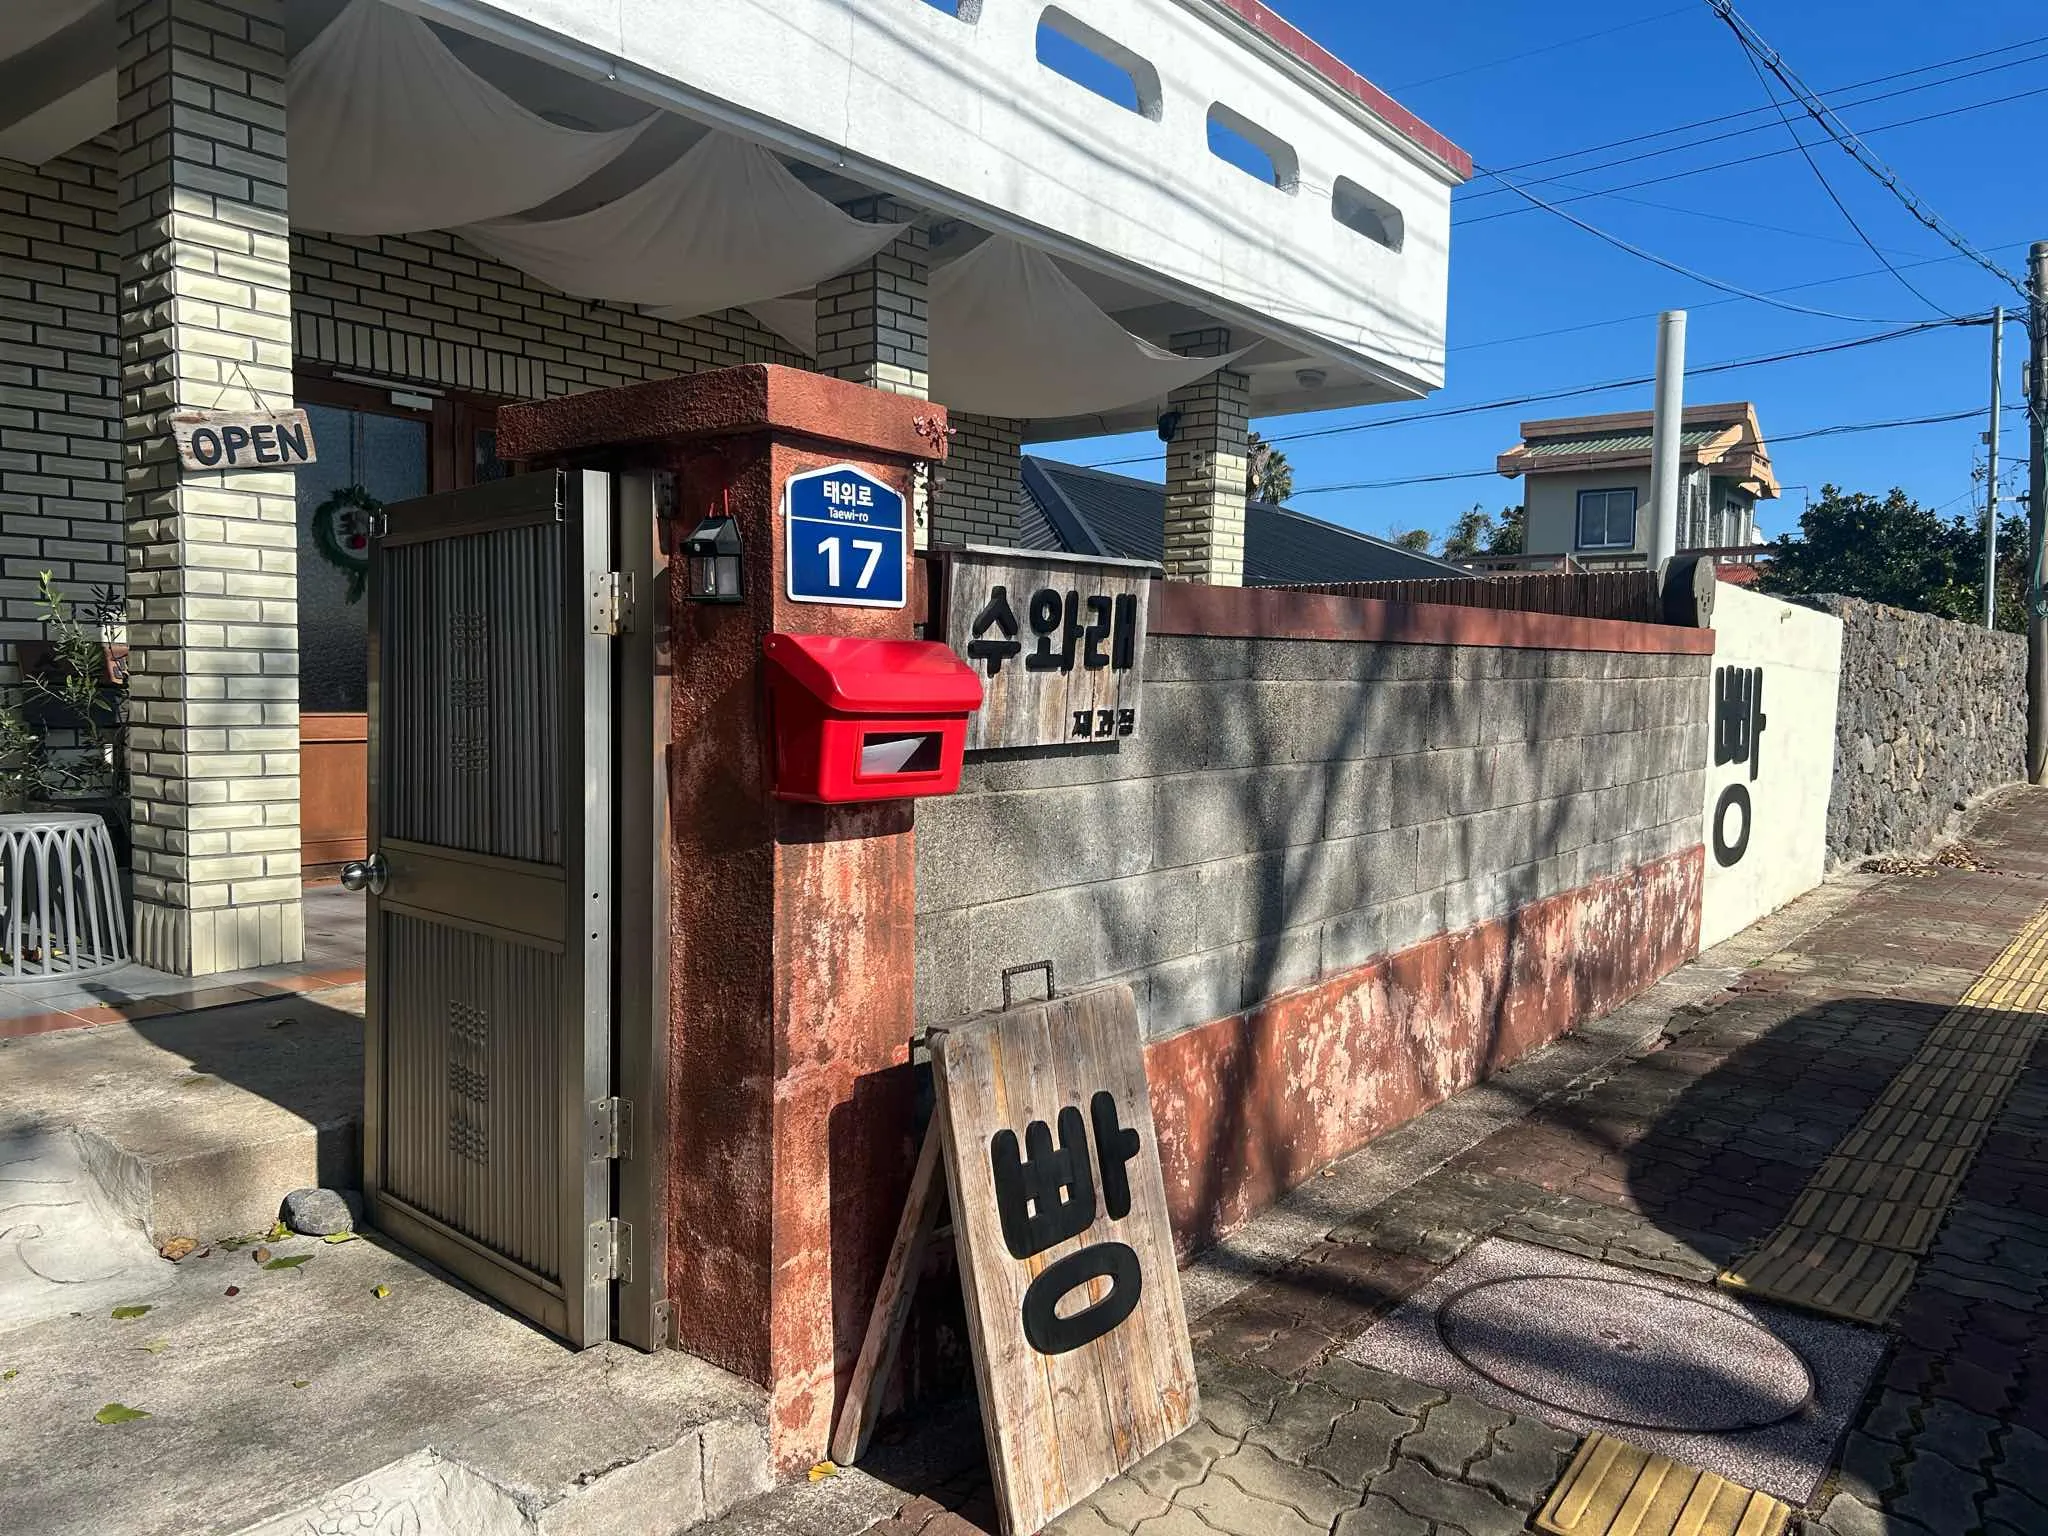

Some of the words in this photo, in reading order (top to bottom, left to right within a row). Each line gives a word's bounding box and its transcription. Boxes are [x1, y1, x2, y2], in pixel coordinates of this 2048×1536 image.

[192, 423, 309, 467] OPEN
[823, 480, 874, 507] 태위로
[828, 507, 869, 522] Taewi-ro
[818, 536, 883, 589] 17
[967, 585, 1138, 679] 수와래
[1072, 708, 1135, 739] 제과점
[1713, 664, 1767, 868] 빵
[990, 1090, 1143, 1355] 빵
